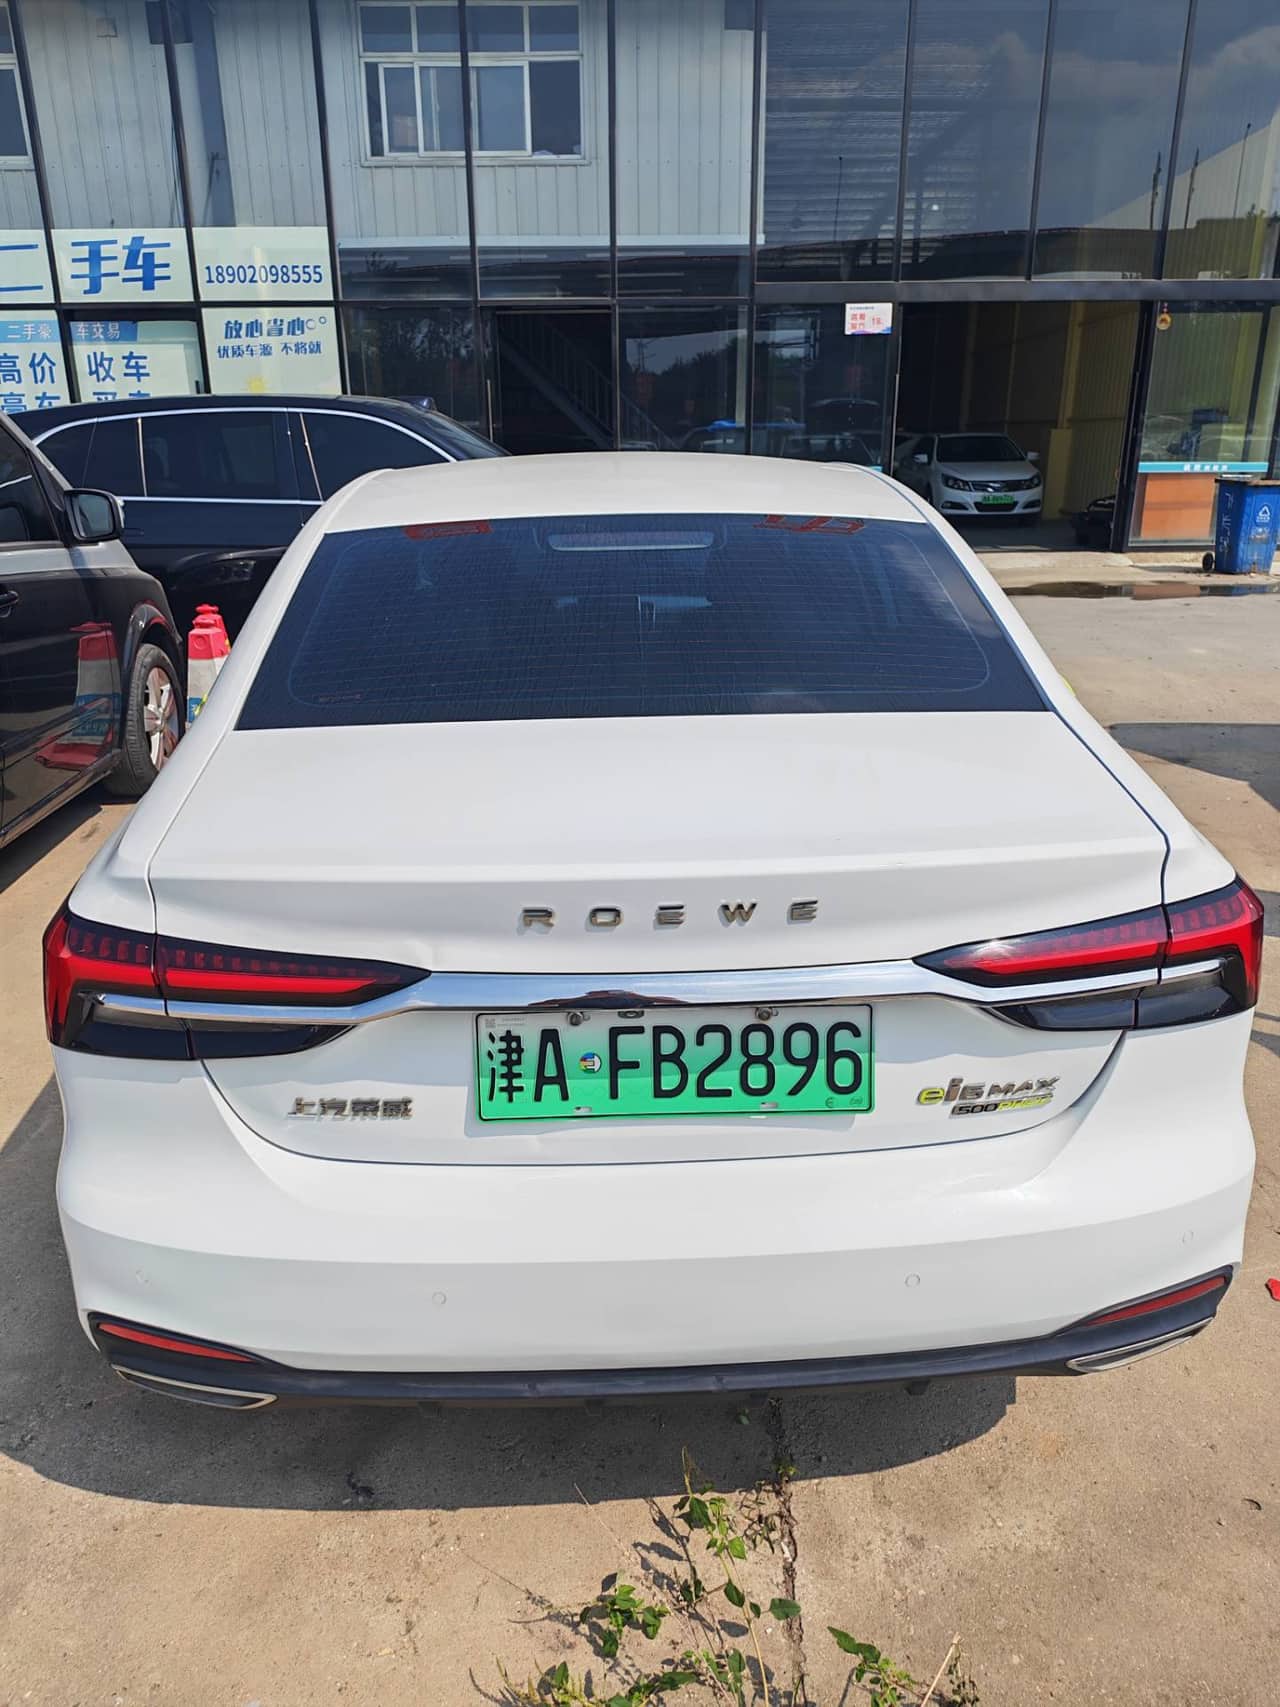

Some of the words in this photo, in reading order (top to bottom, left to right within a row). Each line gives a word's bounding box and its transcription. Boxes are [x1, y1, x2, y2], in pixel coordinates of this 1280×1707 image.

[205, 264, 323, 284] 18902098555
[521, 899, 819, 928] ROEWE
[986, 1076, 1061, 1097] MAX
